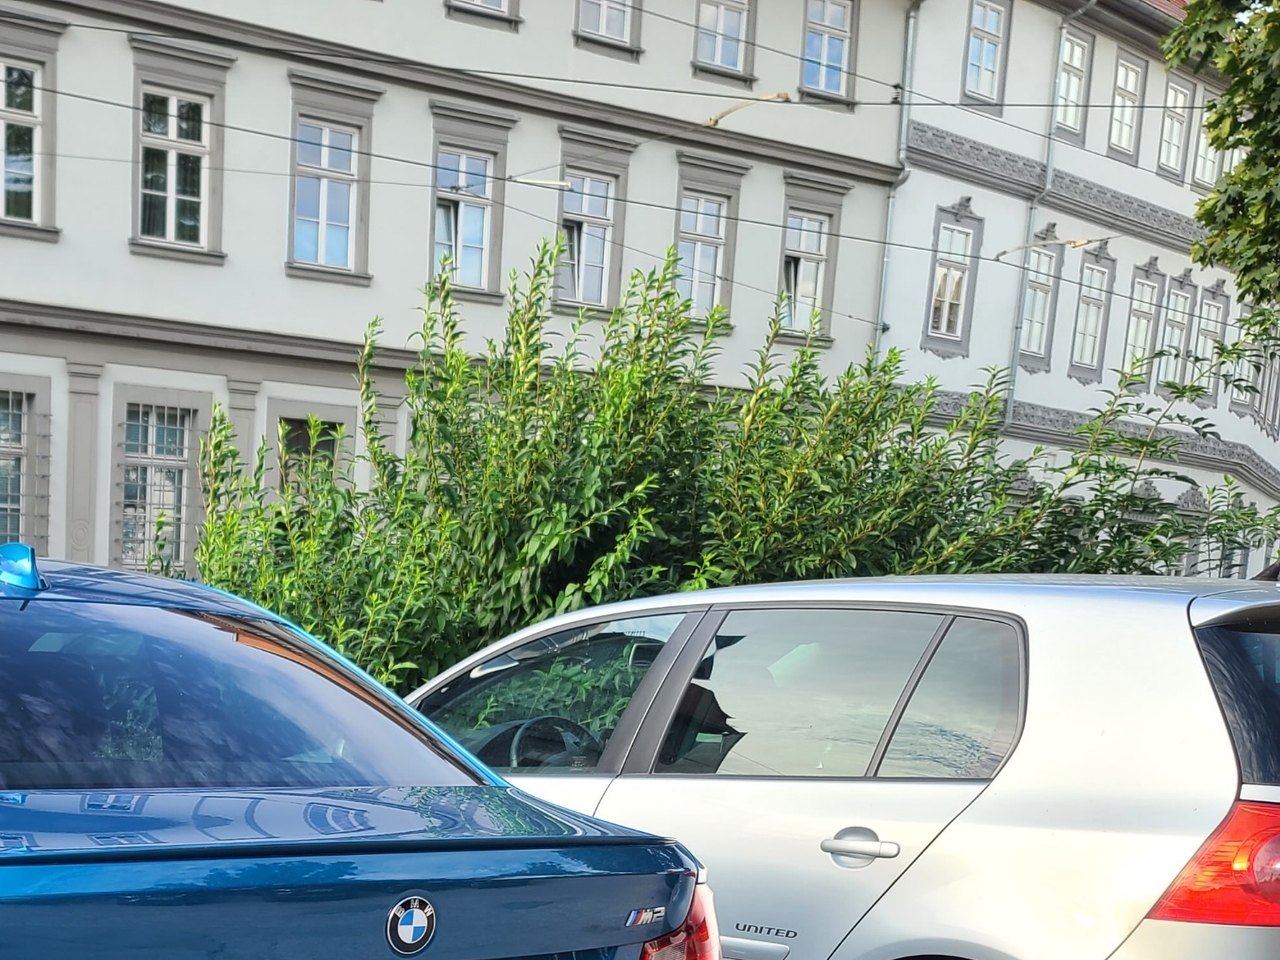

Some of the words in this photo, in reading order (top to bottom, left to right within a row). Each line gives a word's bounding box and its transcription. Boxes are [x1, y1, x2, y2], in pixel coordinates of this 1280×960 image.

[394, 899, 433, 918] BMW
[636, 906, 666, 925] M2
[735, 922, 798, 939] UNITED
